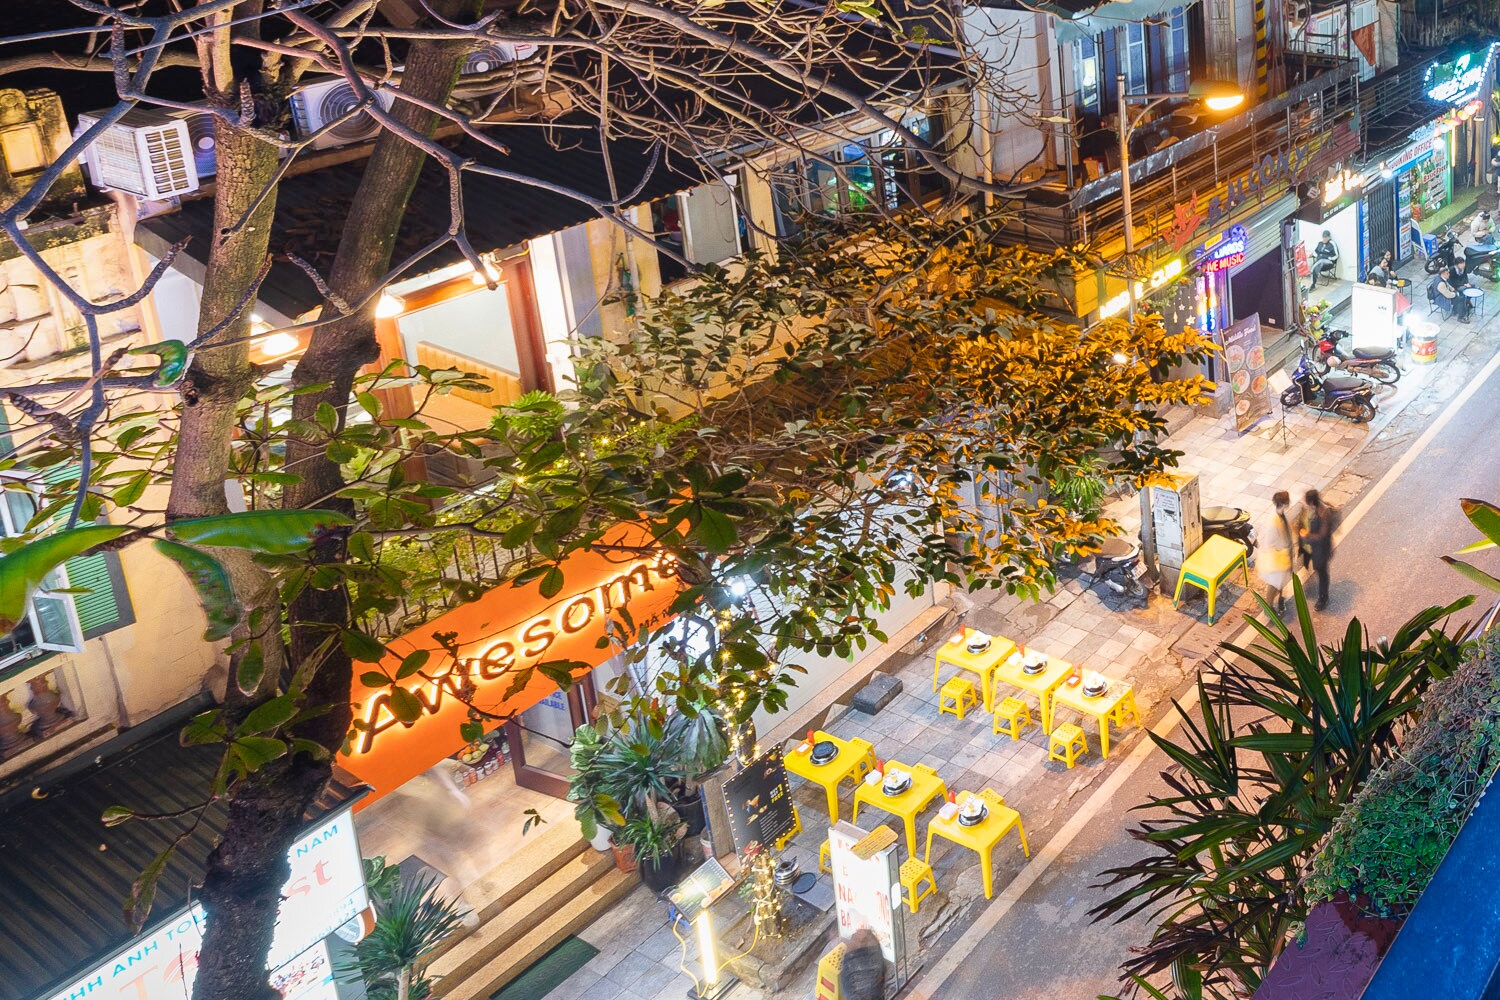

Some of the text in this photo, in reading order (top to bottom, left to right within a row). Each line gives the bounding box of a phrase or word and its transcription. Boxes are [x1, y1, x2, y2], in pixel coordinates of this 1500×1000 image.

[1209, 144, 1308, 227] BALCONY
[1204, 253, 1244, 272] IVE MUSIC
[112, 940, 158, 978] ANH
[165, 909, 208, 941] TOU
[296, 824, 338, 858] NAM
